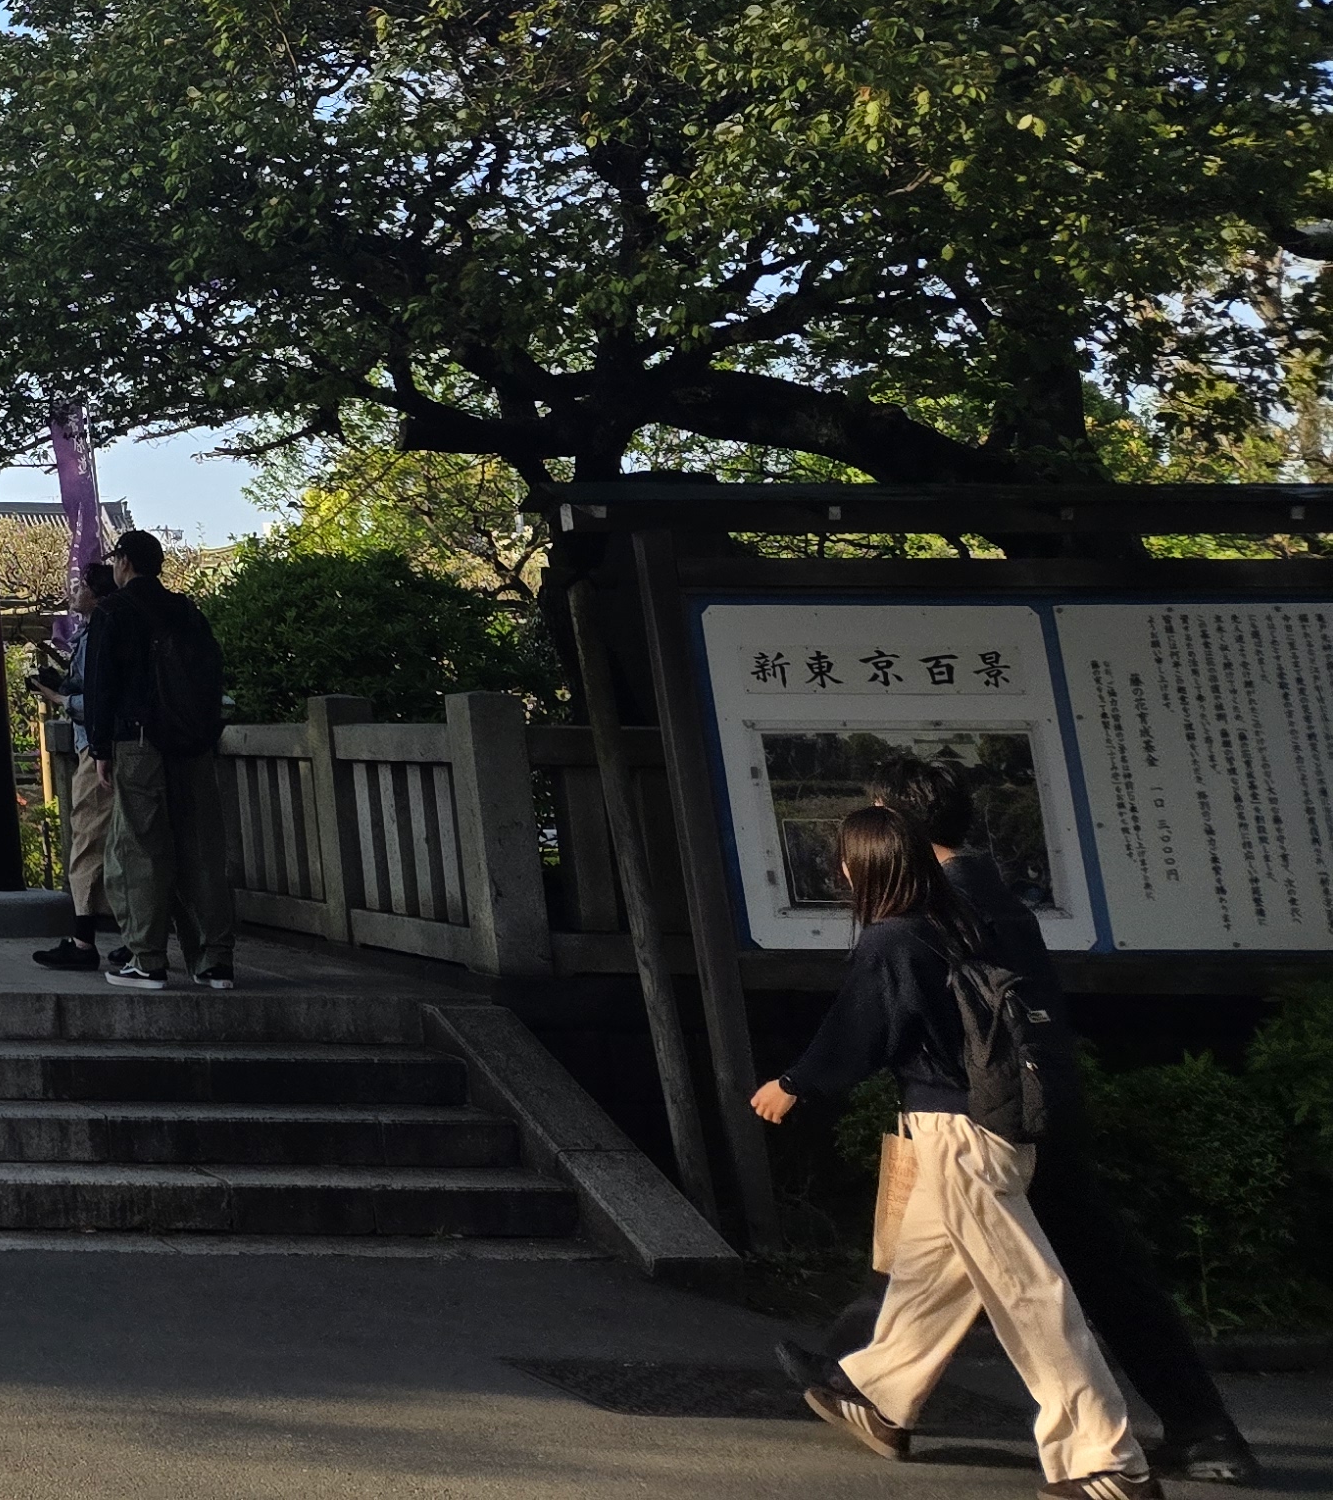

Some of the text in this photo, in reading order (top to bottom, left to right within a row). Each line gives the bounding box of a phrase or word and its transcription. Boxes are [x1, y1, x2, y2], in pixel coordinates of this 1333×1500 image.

[751, 650, 1011, 689] 新東京百景
